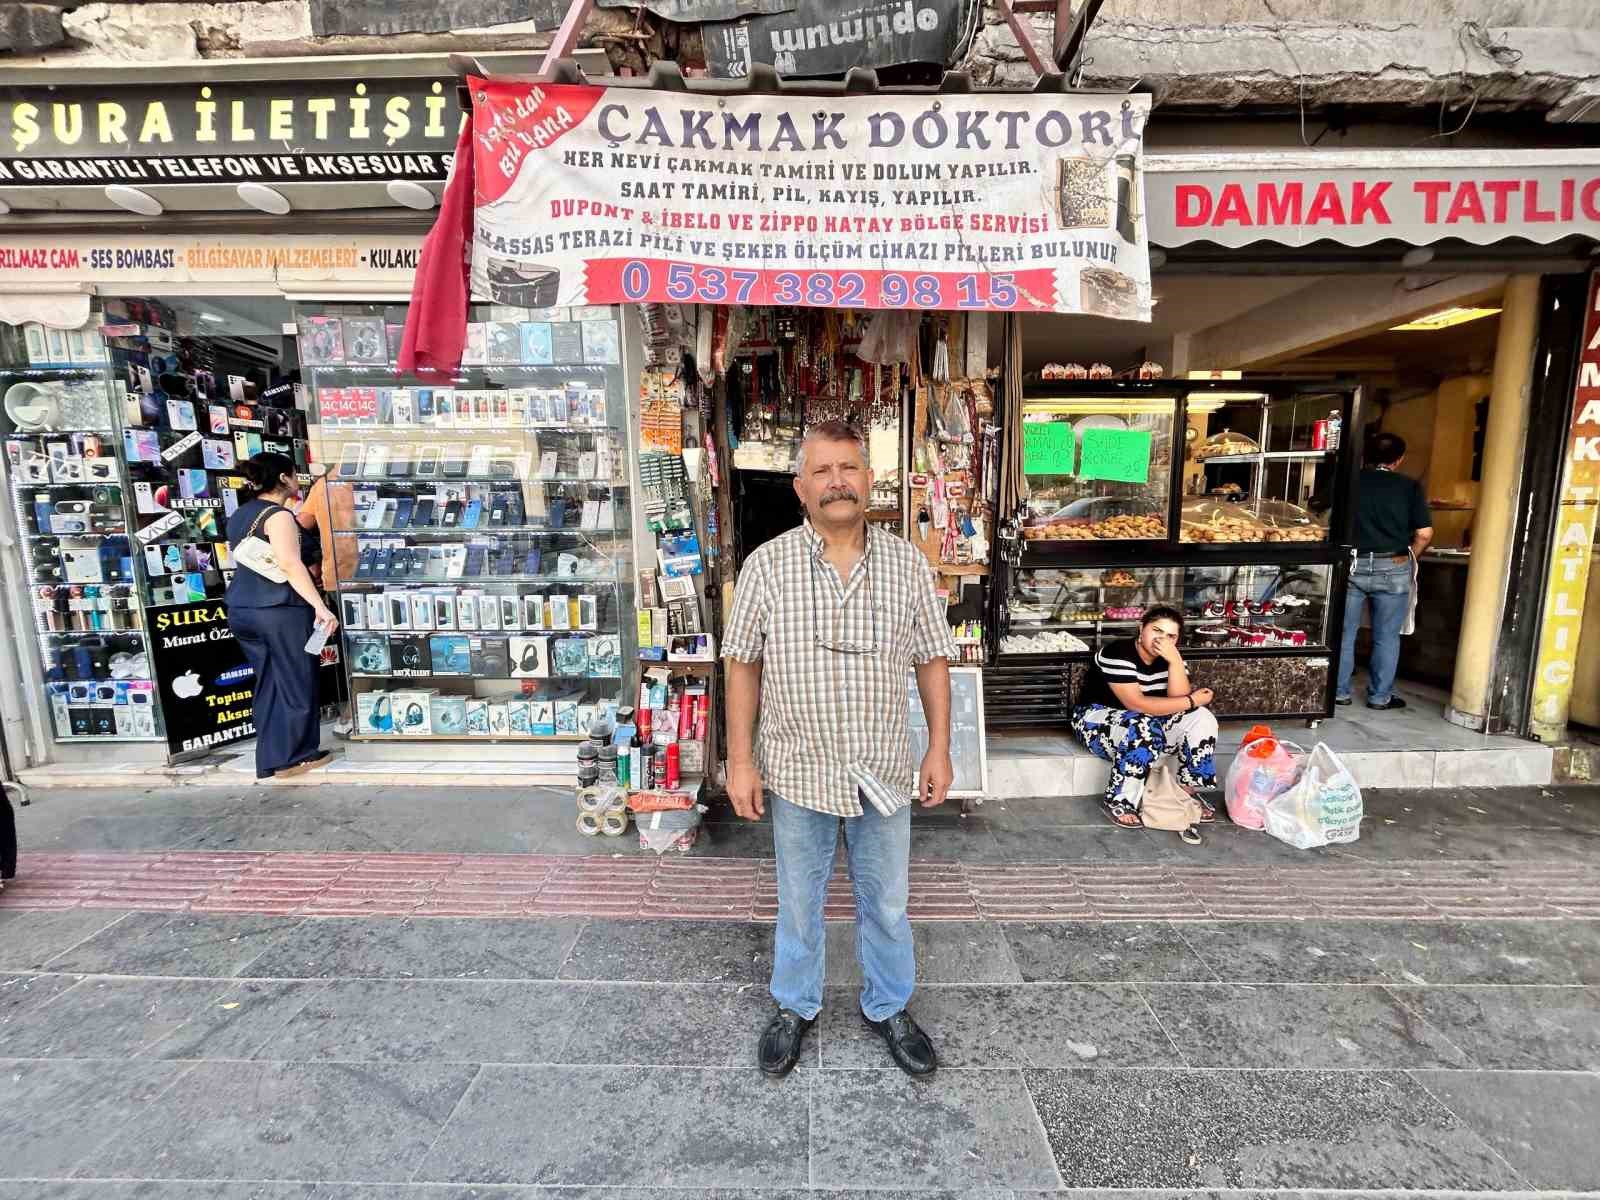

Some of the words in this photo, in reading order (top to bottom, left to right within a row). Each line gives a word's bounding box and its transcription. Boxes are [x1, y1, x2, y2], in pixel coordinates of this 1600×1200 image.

[771, 1, 938, 52] optimum
[11, 100, 174, 152] ŞURA
[195, 81, 468, 147] İLETİŞİ
[598, 103, 847, 151] ÇAKMAK
[149, 157, 263, 177] TELEFON
[267, 155, 300, 175] VE
[302, 154, 437, 175] AKSESUAR
[564, 150, 604, 168] HER
[611, 153, 660, 169] NEVİ
[667, 157, 752, 176] ÇAKMAK
[760, 160, 834, 180] TAMİRİ
[842, 163, 866, 180] VE
[874, 163, 942, 180] DOLUM
[948, 160, 1038, 180] YAPILIR.
[621, 181, 675, 199] SAAT
[682, 180, 764, 203] TAMİRİ,
[773, 184, 811, 205] PİL,
[819, 189, 885, 208] KAYIŞ,
[894, 189, 982, 205] YAPILIR.
[1175, 180, 1392, 227] DAMAK
[551, 200, 634, 220] DUPONT
[642, 212, 653, 224] &
[662, 210, 720, 229] İBELO
[728, 214, 752, 230] VE
[760, 212, 817, 231] ZİPPO
[825, 215, 893, 233] HATAY
[901, 211, 963, 231] BÖLGE
[970, 212, 1048, 234] SERVİSİ
[50, 248, 79, 269] CAM
[91, 248, 113, 269] SES
[117, 248, 175, 269] BOMBASI
[187, 241, 262, 269] BİLGİSAYAR
[370, 248, 421, 269] KULAKL
[560, 227, 632, 249] TERAZİ
[640, 232, 682, 253] PİLİ
[690, 240, 715, 256] VE
[723, 242, 786, 261] ŞEKER
[794, 239, 862, 261] ÖLÇÜM
[870, 239, 937, 260] CİHAZI
[945, 242, 1024, 263] PİLLERİ
[1032, 240, 1118, 264] BULUNUR
[622, 261, 650, 300] 0
[667, 264, 757, 302] 537
[774, 271, 865, 307] 382
[882, 273, 942, 307] 98
[957, 273, 1017, 308] 15
[156, 606, 228, 631] ŞURA
[163, 632, 207, 649] Murat
[209, 627, 235, 641] ÖZ
[205, 690, 252, 707] Toptan
[217, 708, 253, 724] Akse
